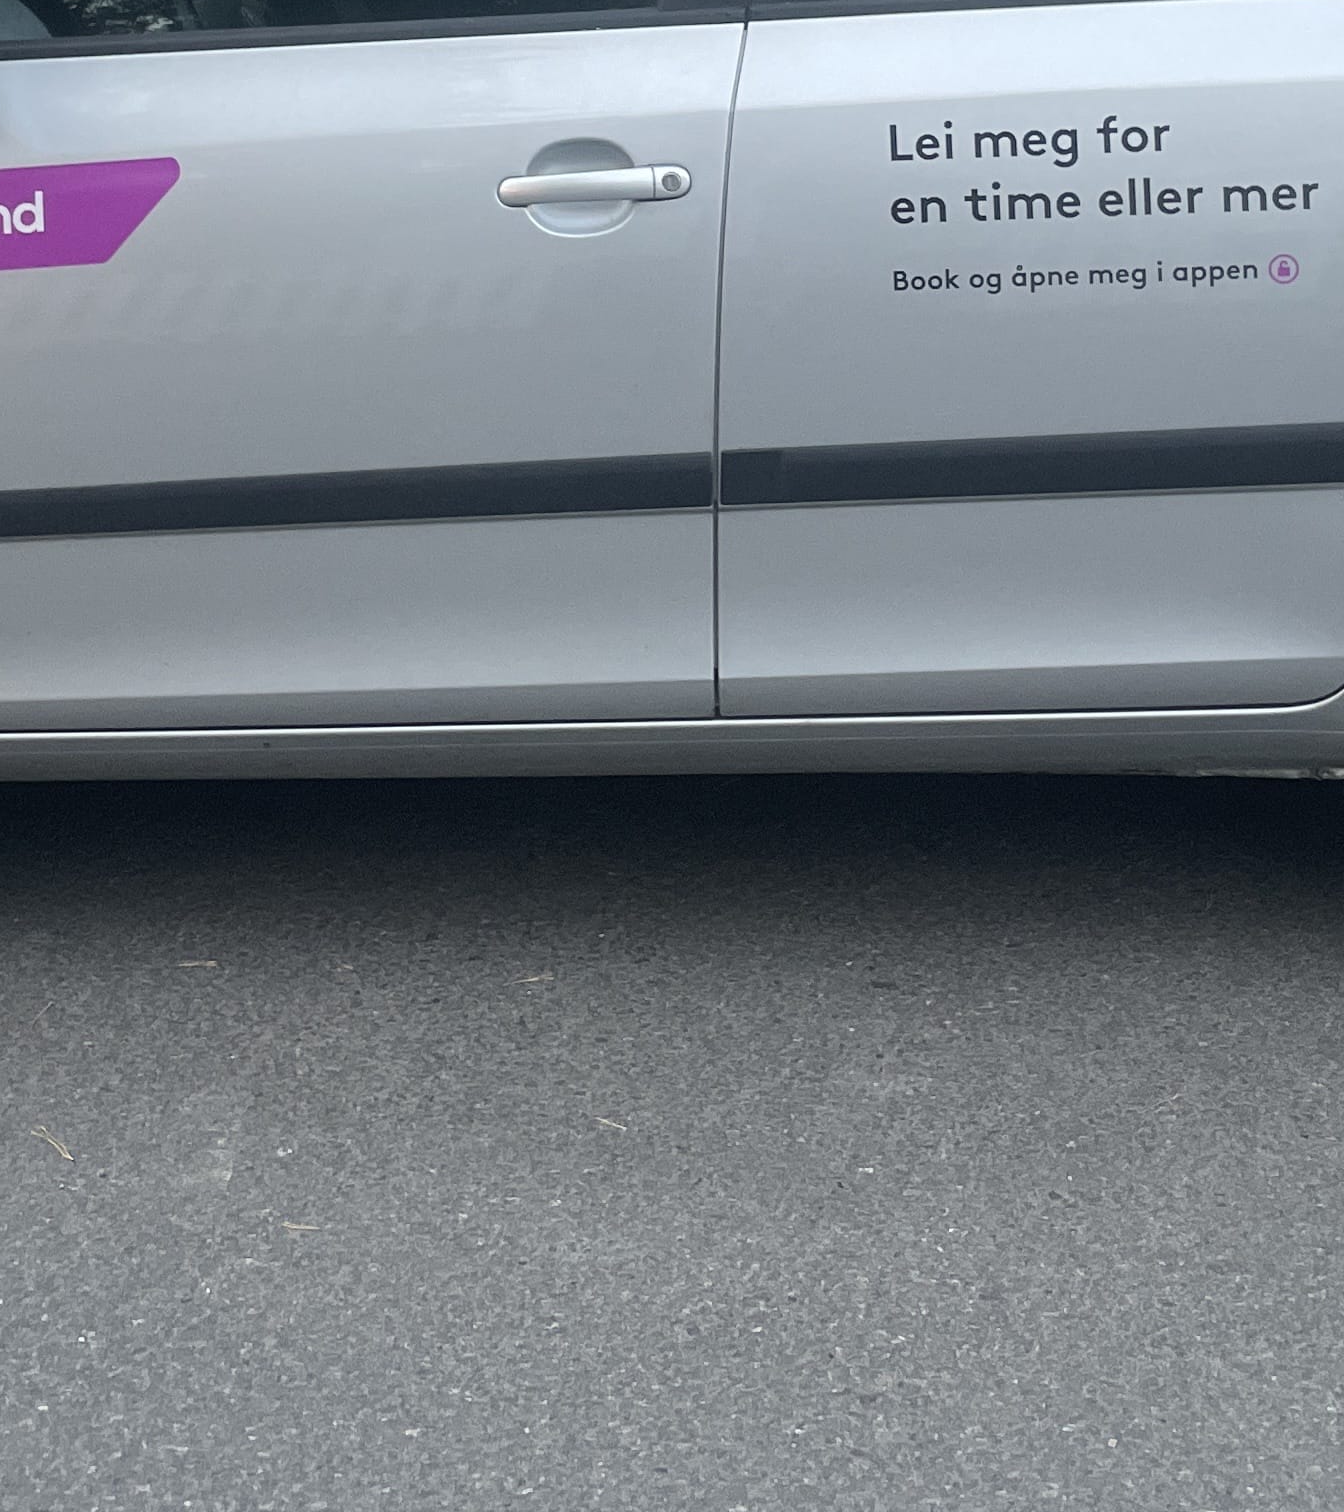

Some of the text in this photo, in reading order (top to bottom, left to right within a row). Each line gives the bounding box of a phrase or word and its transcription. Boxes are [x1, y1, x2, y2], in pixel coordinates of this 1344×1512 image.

[889, 115, 1171, 168] Lei meg for
[890, 177, 1320, 224] en time eller mer
[892, 261, 1258, 294] Book og åpne meg i appen
